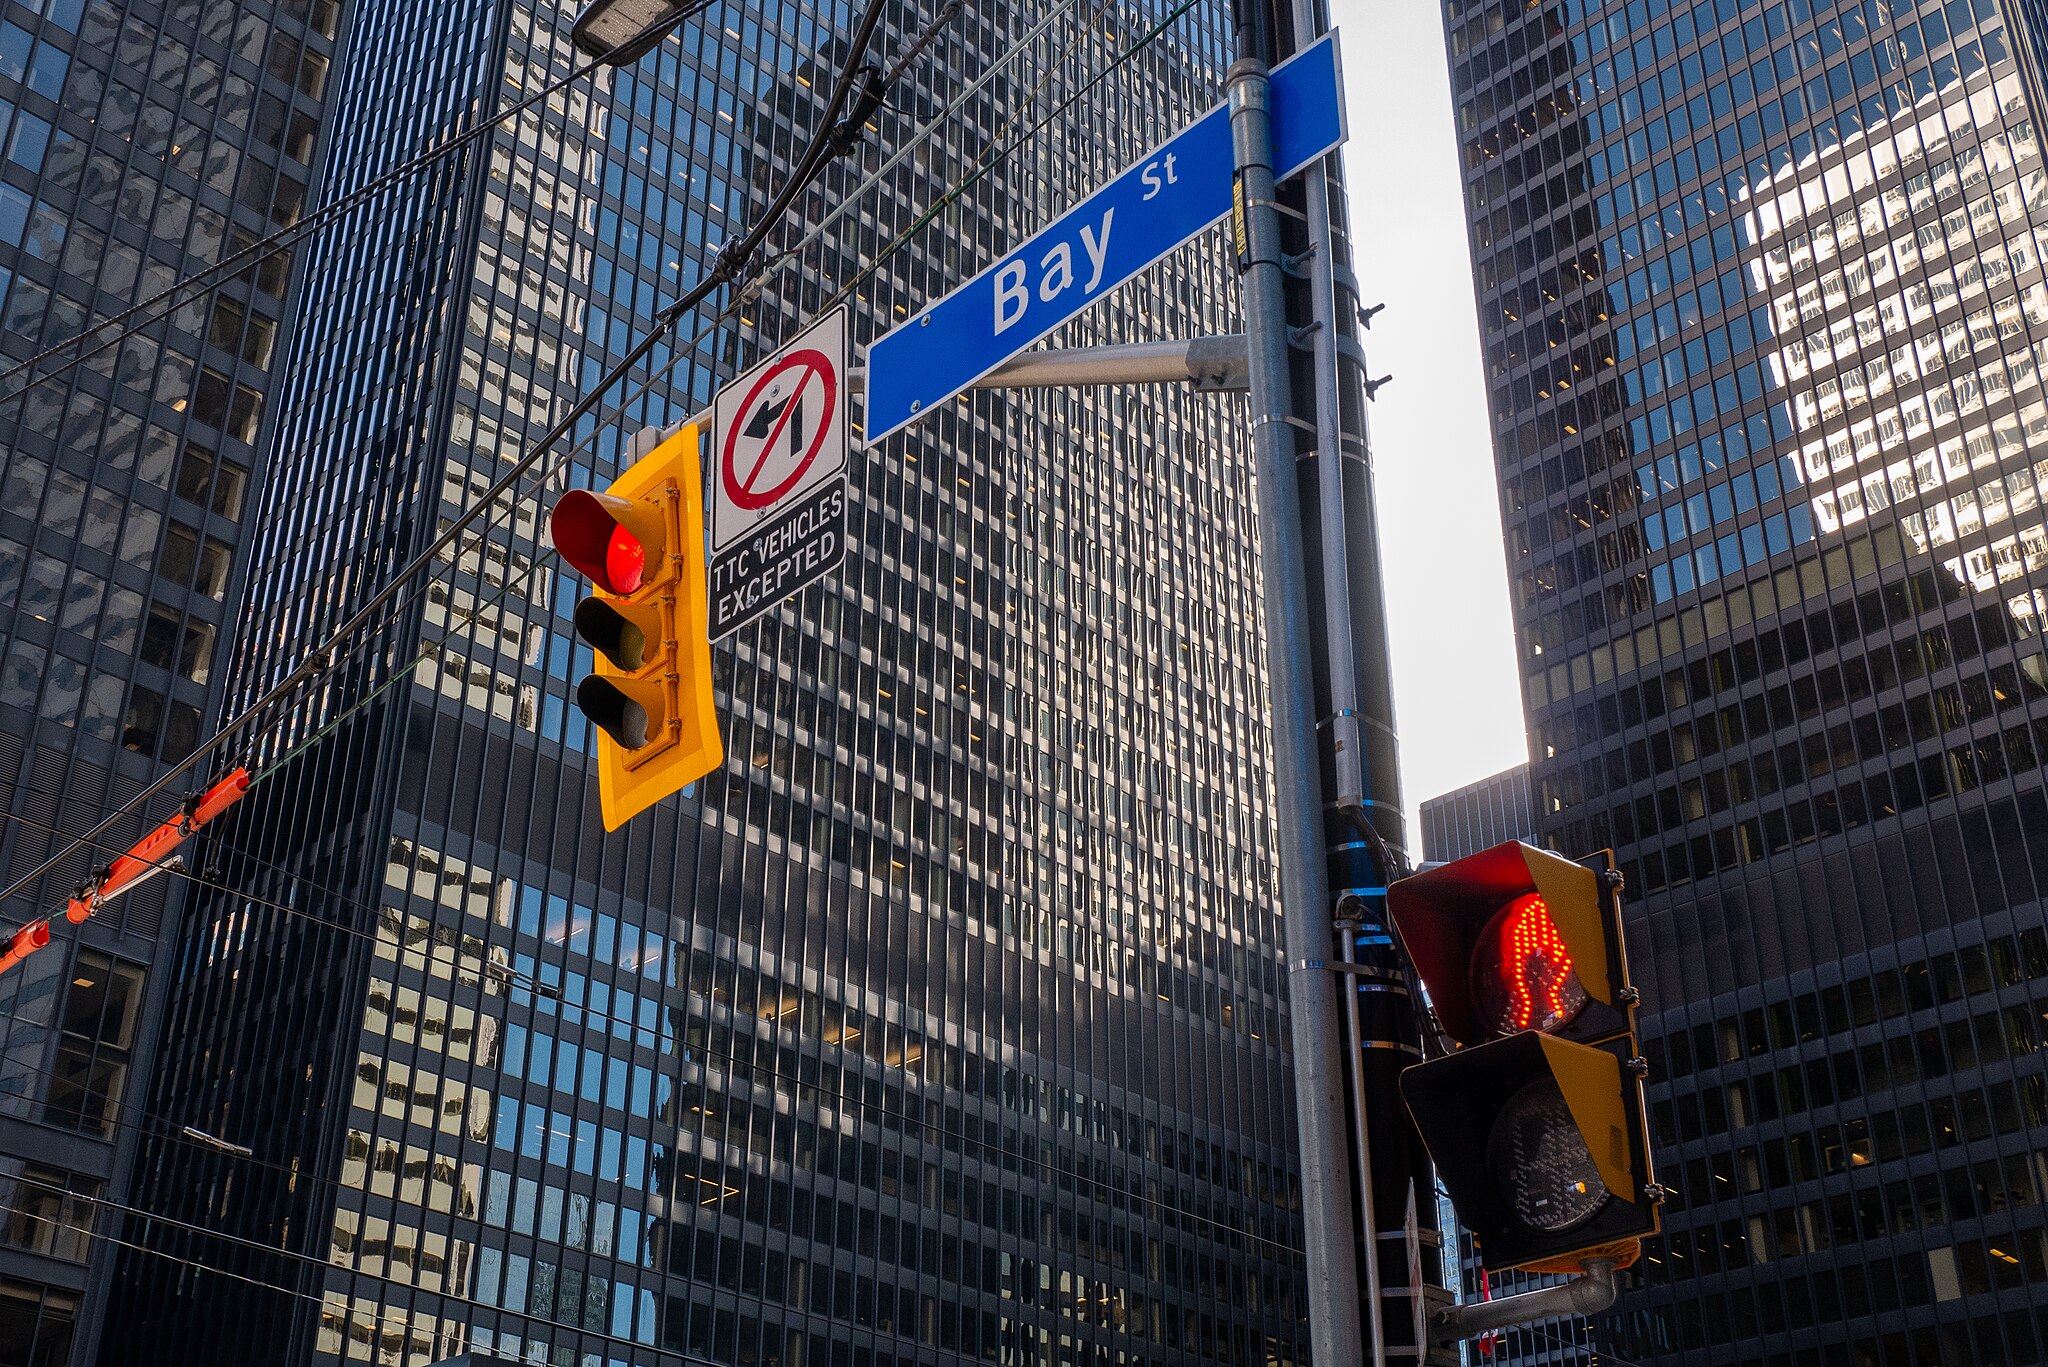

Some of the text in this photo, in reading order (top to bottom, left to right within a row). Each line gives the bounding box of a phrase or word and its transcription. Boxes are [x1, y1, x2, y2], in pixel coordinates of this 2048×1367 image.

[994, 152, 1178, 337] Bay St
[714, 489, 842, 592] TTC VEHICLES
[718, 531, 836, 625] EXCEPTED
